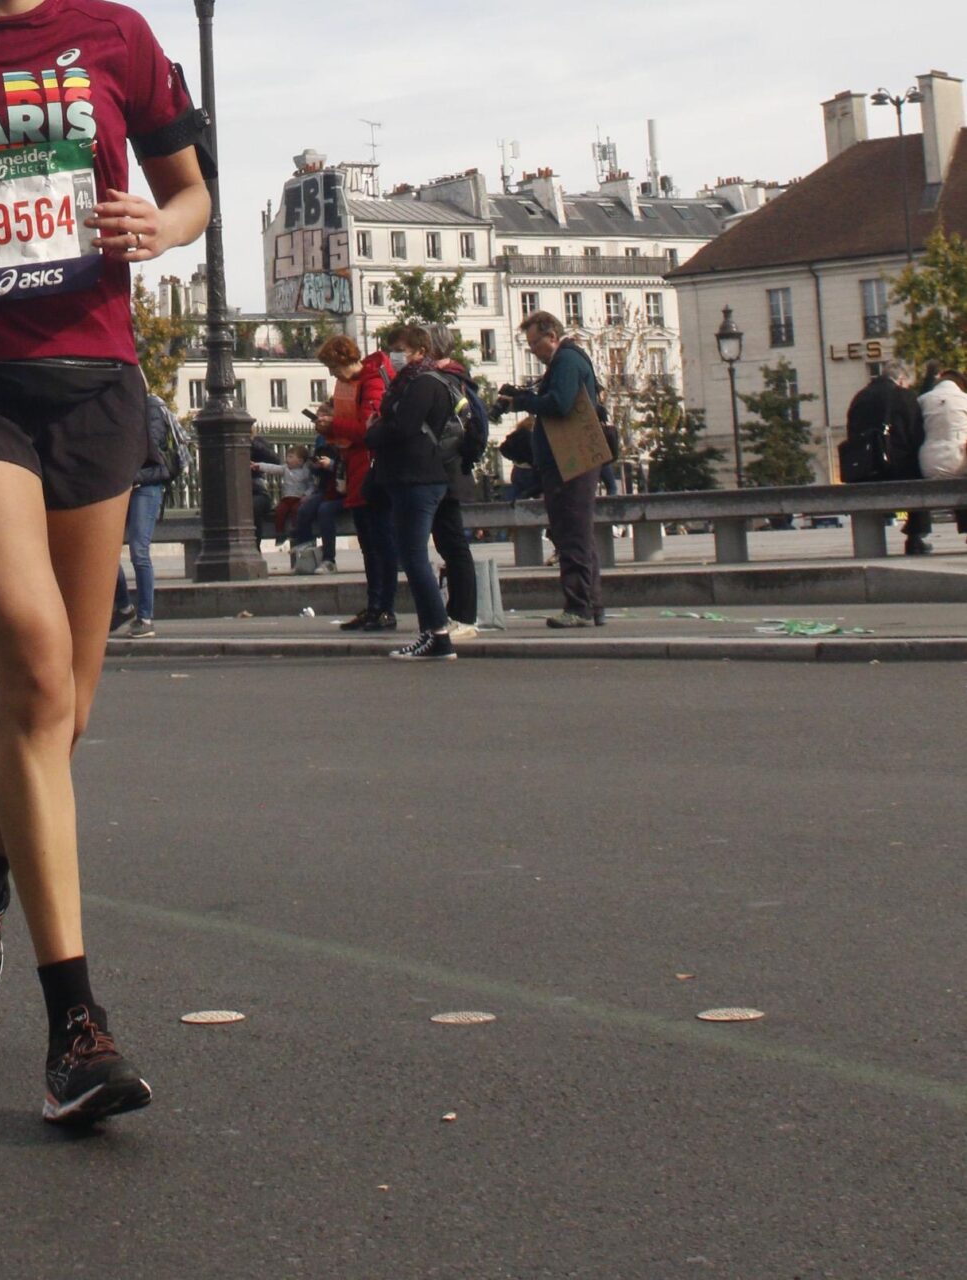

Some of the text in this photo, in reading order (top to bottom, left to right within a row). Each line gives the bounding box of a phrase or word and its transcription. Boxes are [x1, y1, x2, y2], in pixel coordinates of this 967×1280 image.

[10, 159, 56, 176] Electric
[18, 268, 63, 289] asics
[830, 341, 882, 361] LES
